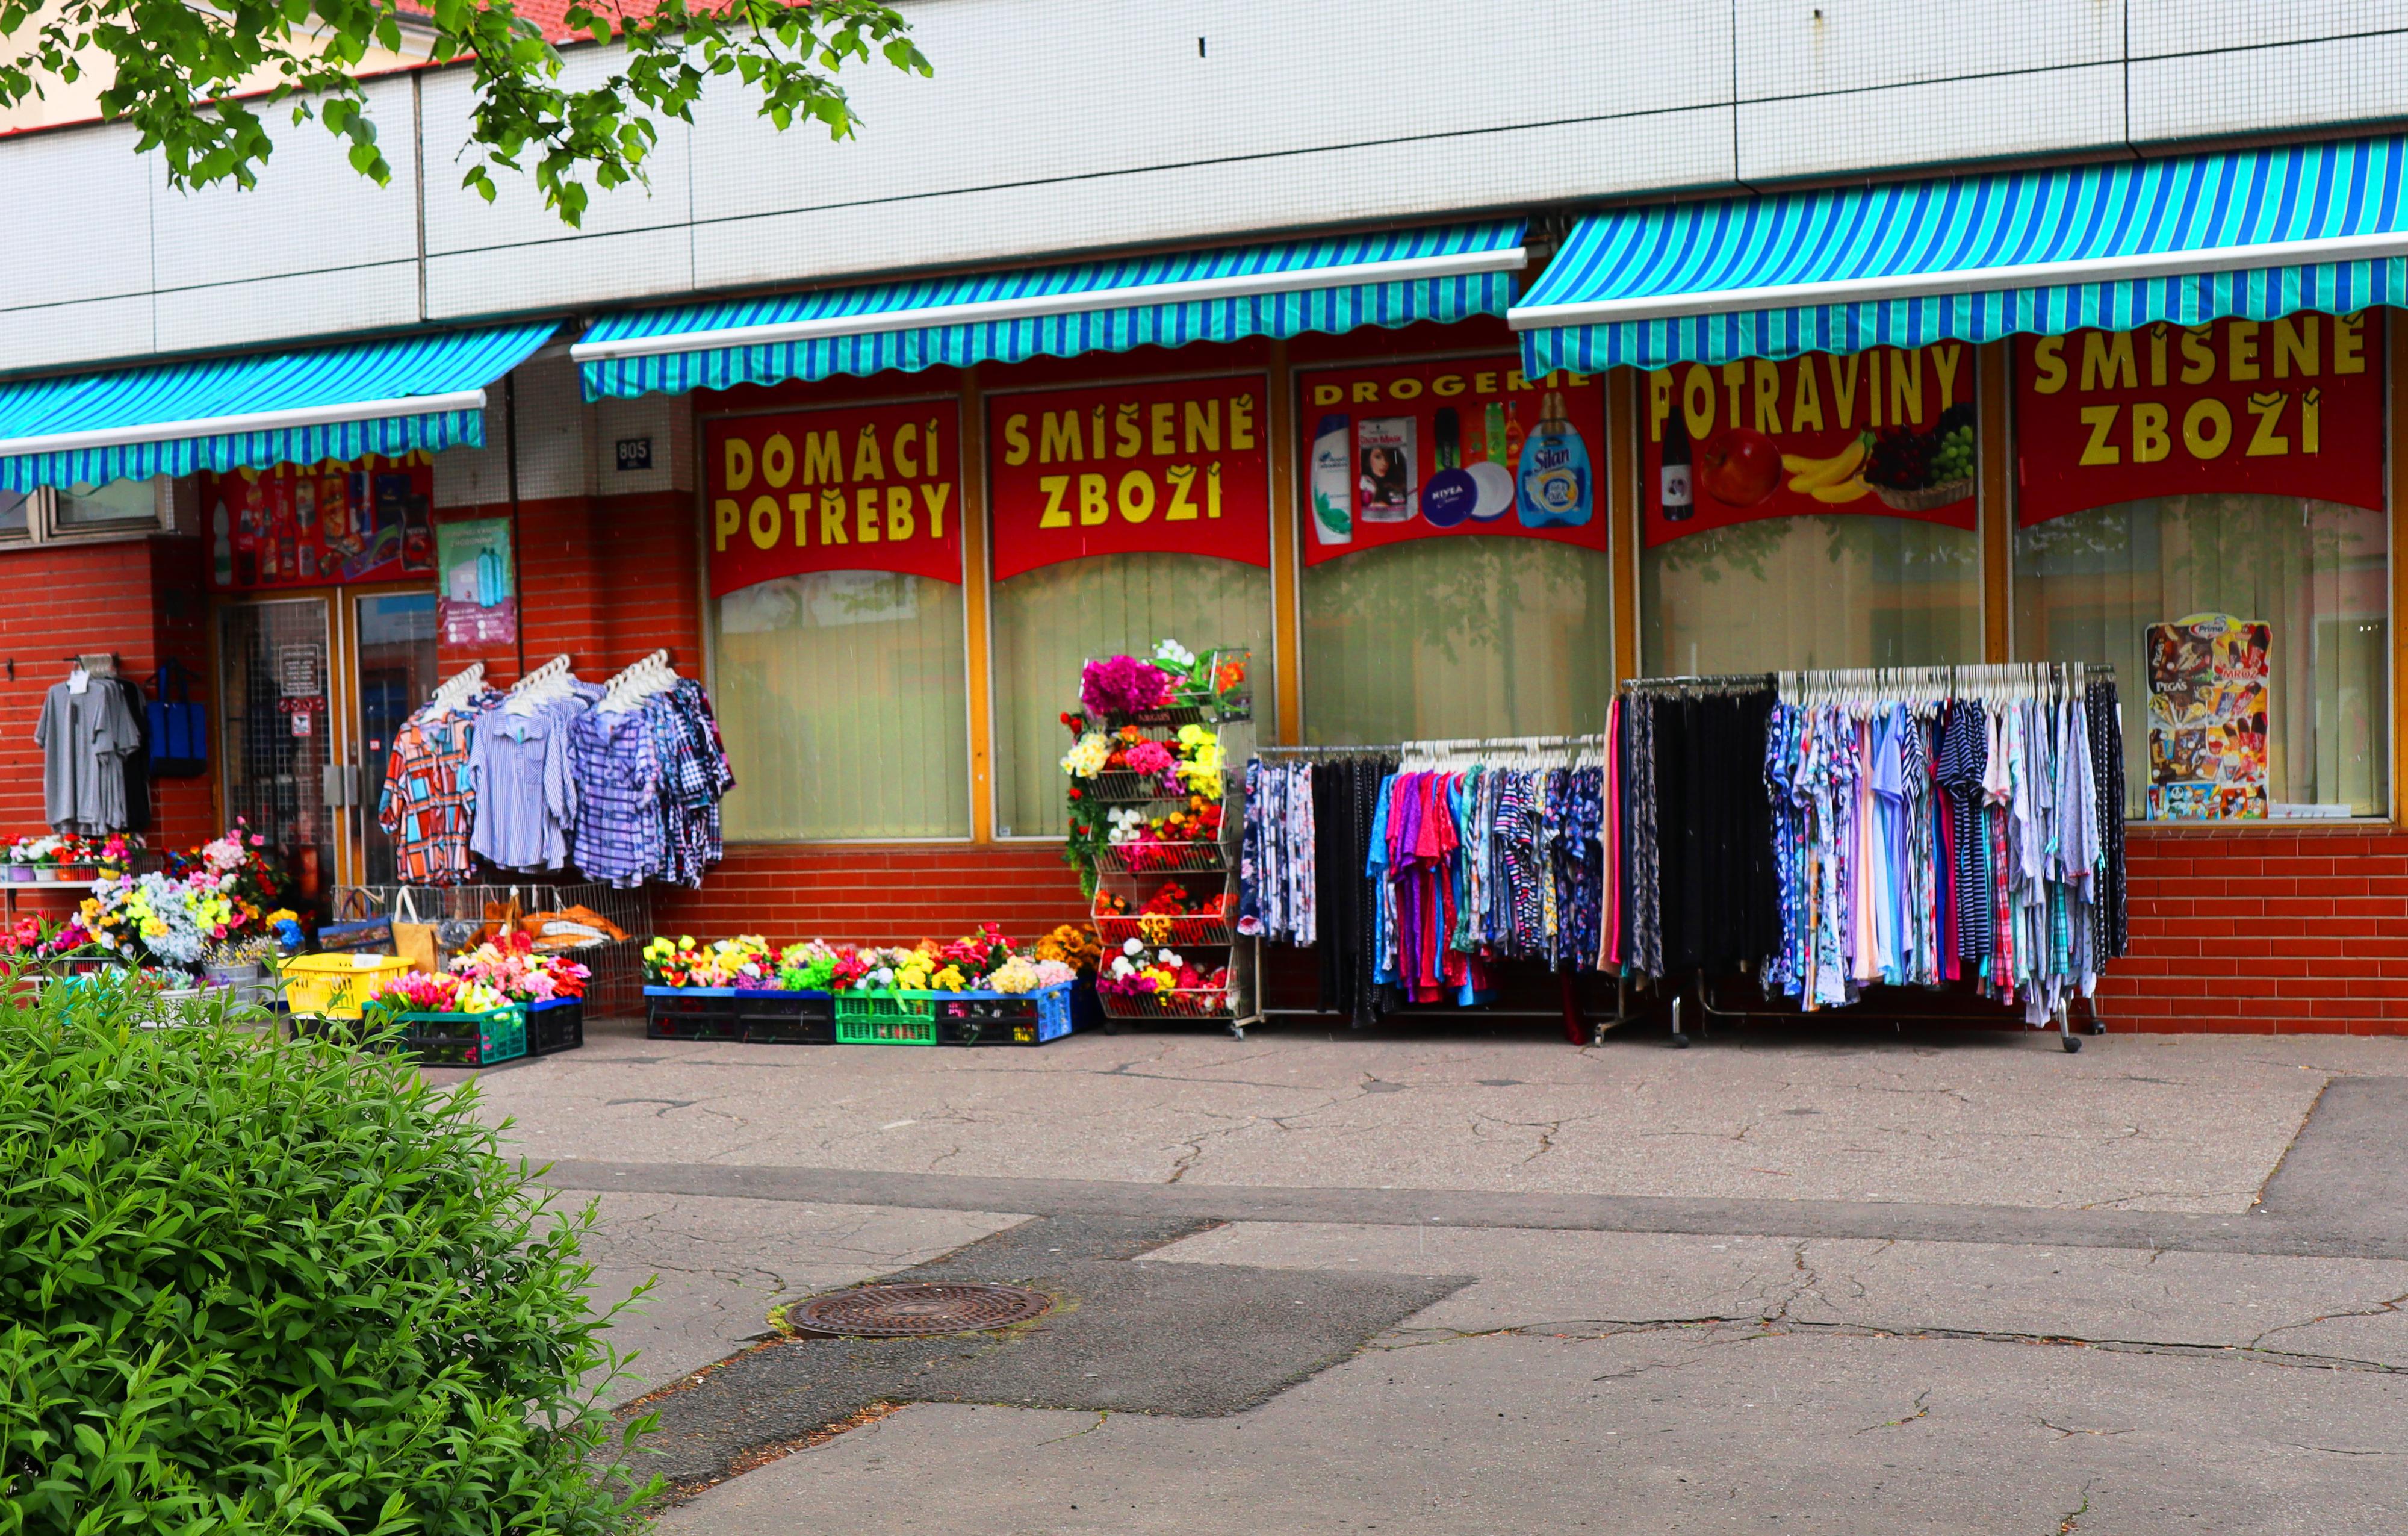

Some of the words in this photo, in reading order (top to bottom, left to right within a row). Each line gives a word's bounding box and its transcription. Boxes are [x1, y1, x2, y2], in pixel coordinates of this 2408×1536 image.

[2034, 310, 2366, 394] SMÍŠENÉ
[1314, 369, 1590, 406] DROGERIE
[1649, 343, 1962, 443] POTRAVINY
[619, 441, 647, 459] 805
[724, 417, 939, 491] DOMÁCÍ
[1004, 393, 1255, 467] SMÍŠENÉ
[1534, 447, 1570, 473] Silan
[2078, 386, 2321, 466] ZBOŽÍ
[715, 482, 951, 552] POTŘEBY
[1038, 460, 1221, 529] ZBOŽÍ
[1432, 484, 1463, 500] NIVEA
